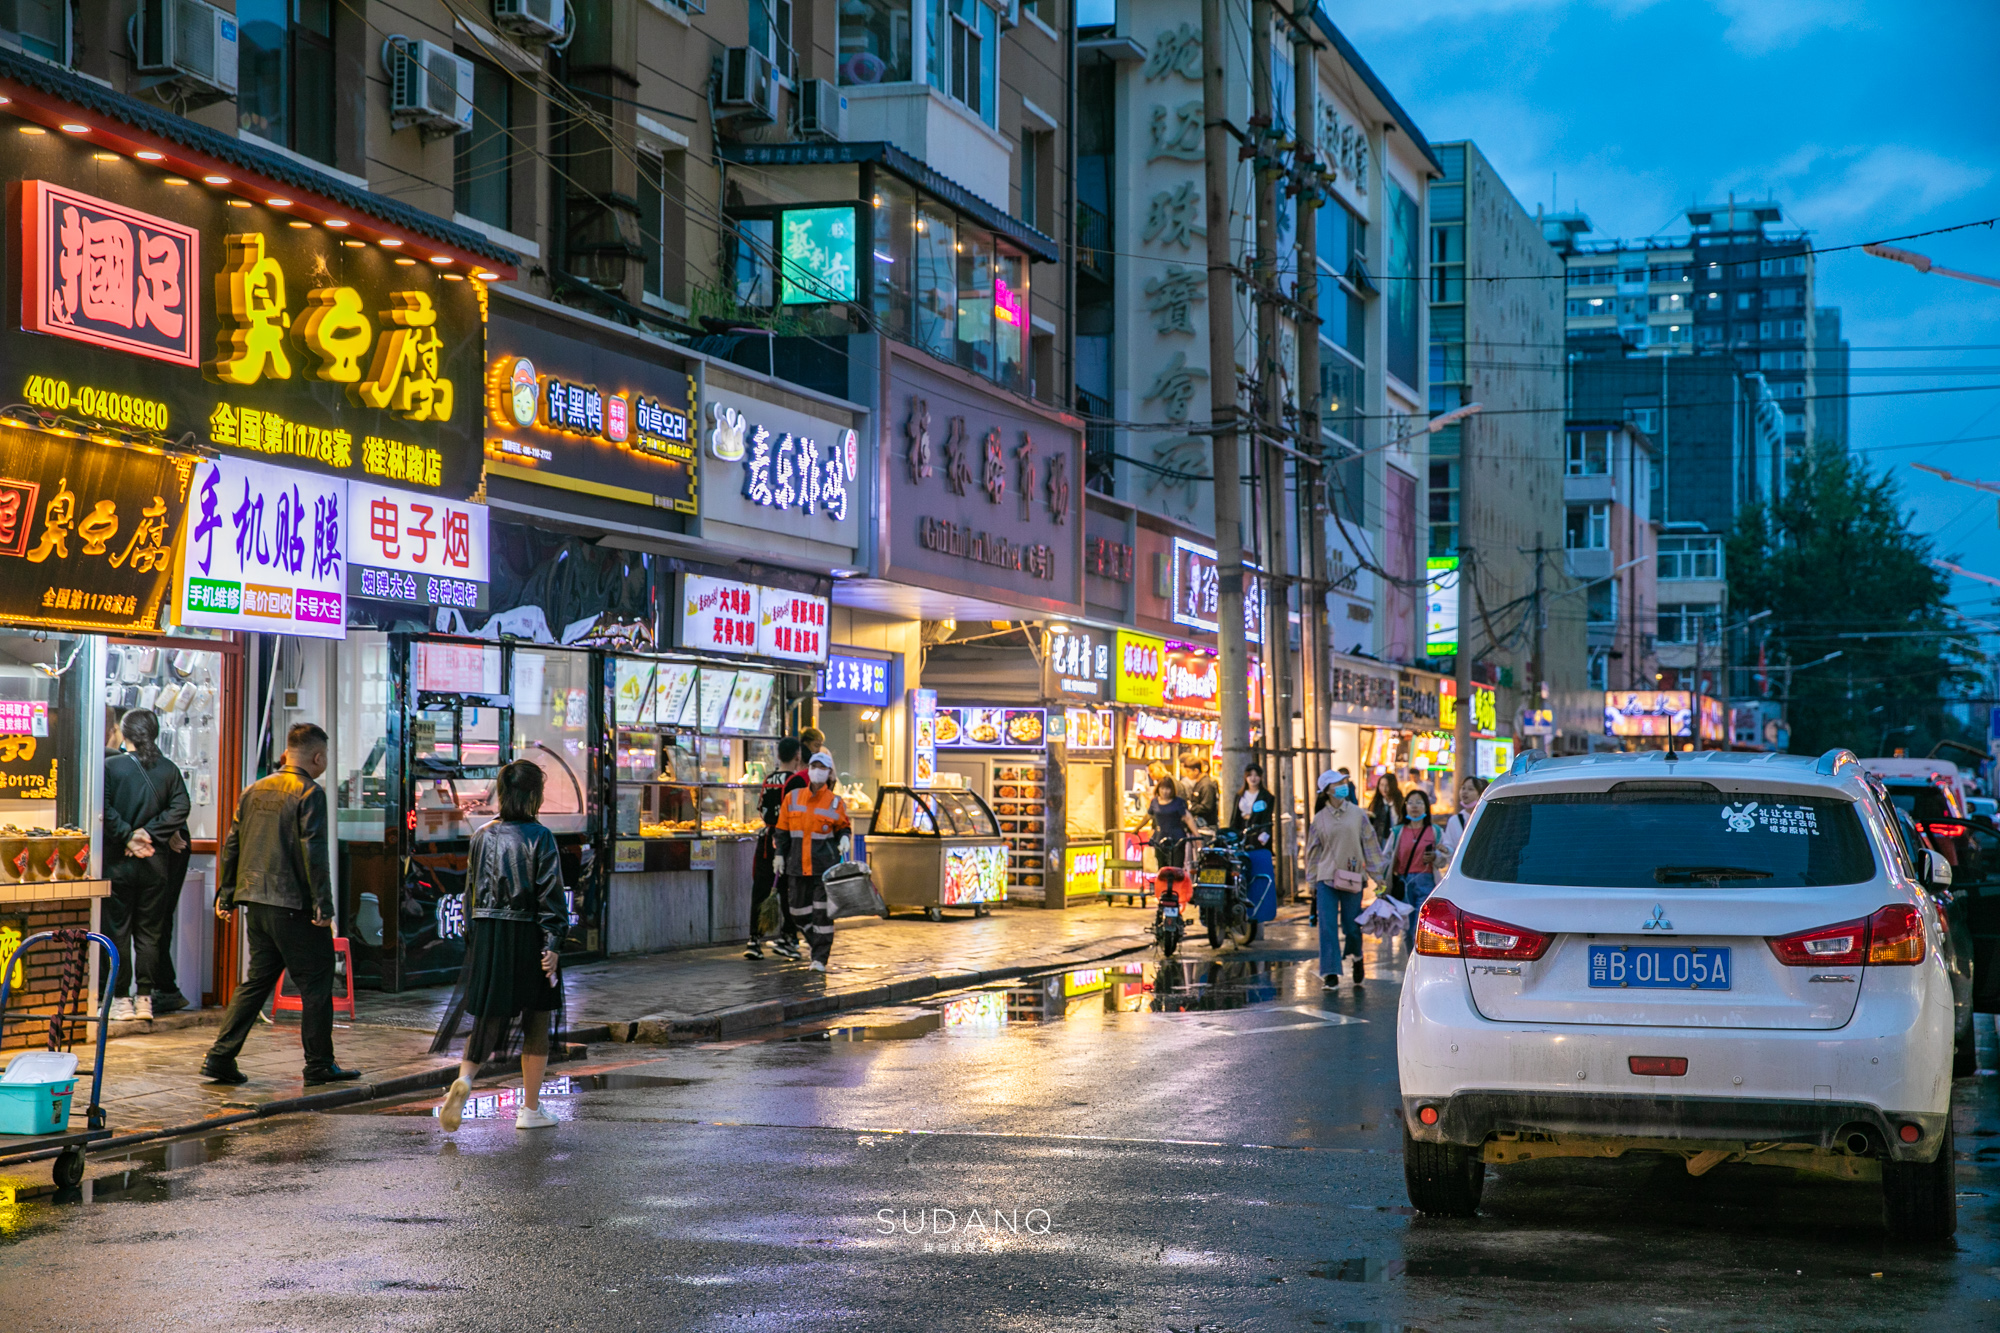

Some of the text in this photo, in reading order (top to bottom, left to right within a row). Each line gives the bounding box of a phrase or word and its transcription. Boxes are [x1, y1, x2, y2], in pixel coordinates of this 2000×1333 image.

[24, 375, 168, 431] 400-0409990
[549, 382, 603, 431] 许黑鸭
[638, 398, 686, 441] 허흑오리
[210, 402, 442, 487] 全国第1178家 桂林路店
[194, 463, 342, 582] 手机贴膜
[370, 496, 470, 568] 电子烟
[42, 587, 137, 616] 全国第1178家店
[188, 585, 241, 609] 手机维修
[244, 590, 293, 614] 高价回收
[361, 568, 417, 600] 烟弹大全
[720, 587, 751, 616] 大鸡排
[297, 599, 341, 619] 卡号大全
